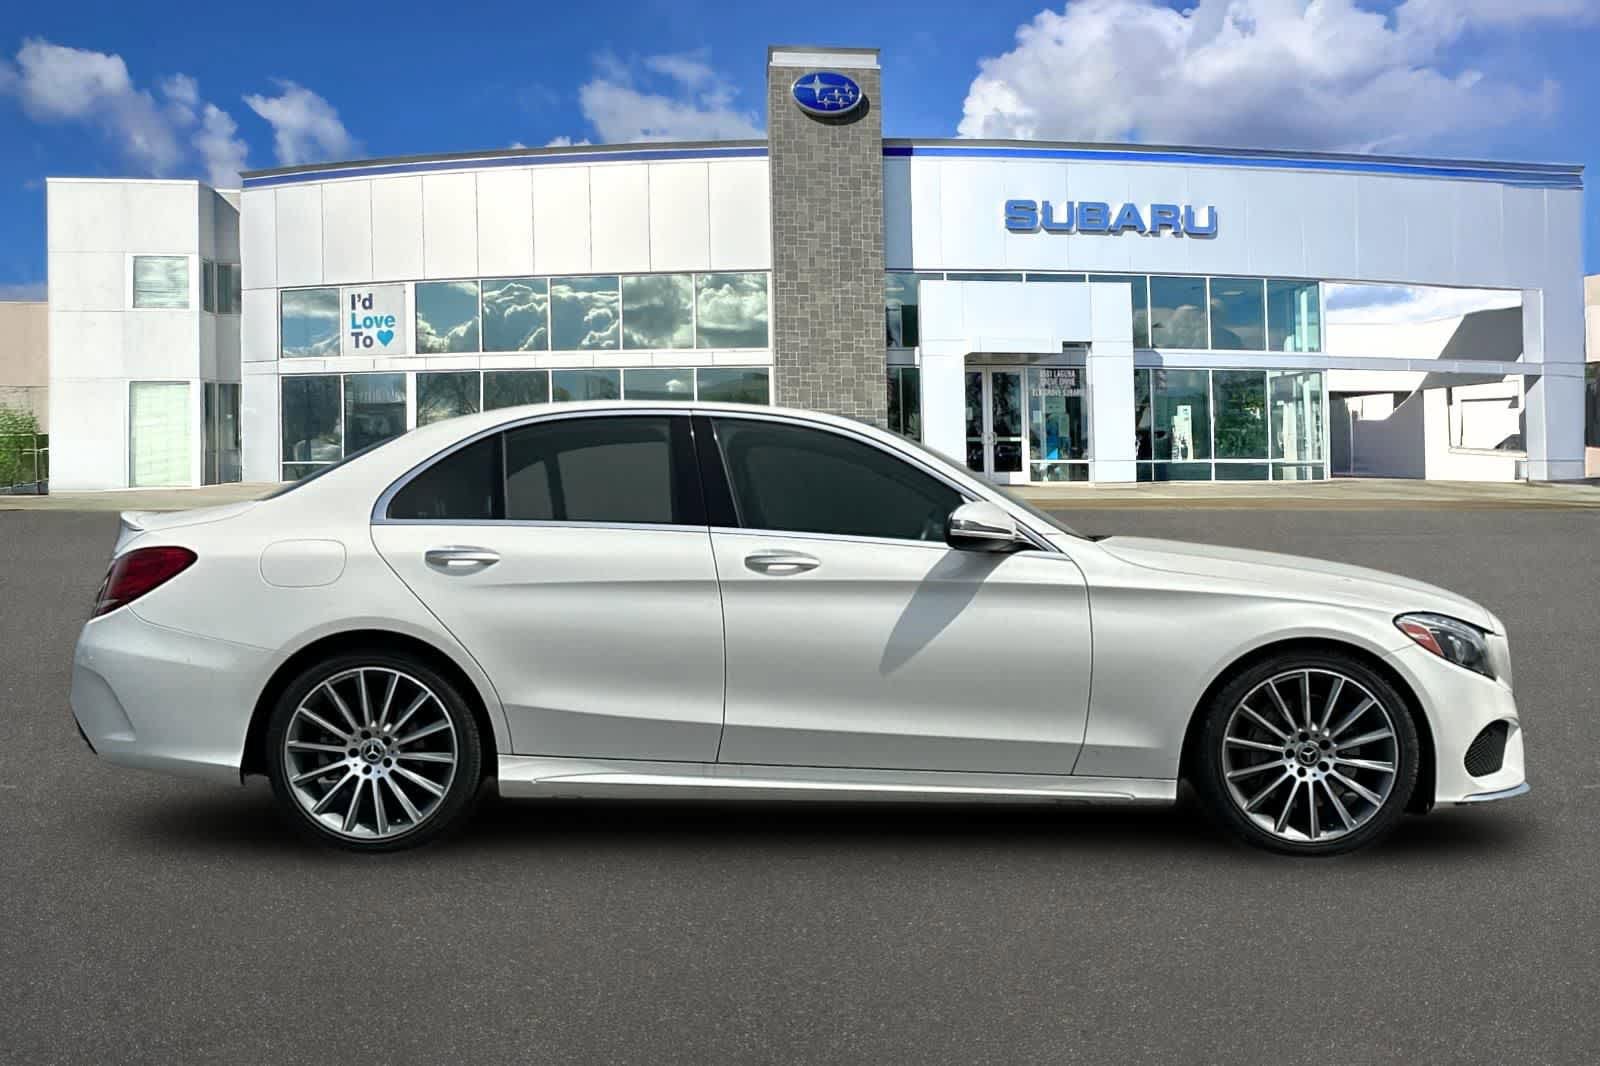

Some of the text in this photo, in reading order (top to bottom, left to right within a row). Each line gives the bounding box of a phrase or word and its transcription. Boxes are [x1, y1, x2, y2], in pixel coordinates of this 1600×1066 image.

[1005, 200, 1217, 238] SUBARU
[351, 293, 373, 311] I'd
[351, 312, 396, 329] Love
[351, 332, 374, 349] To
